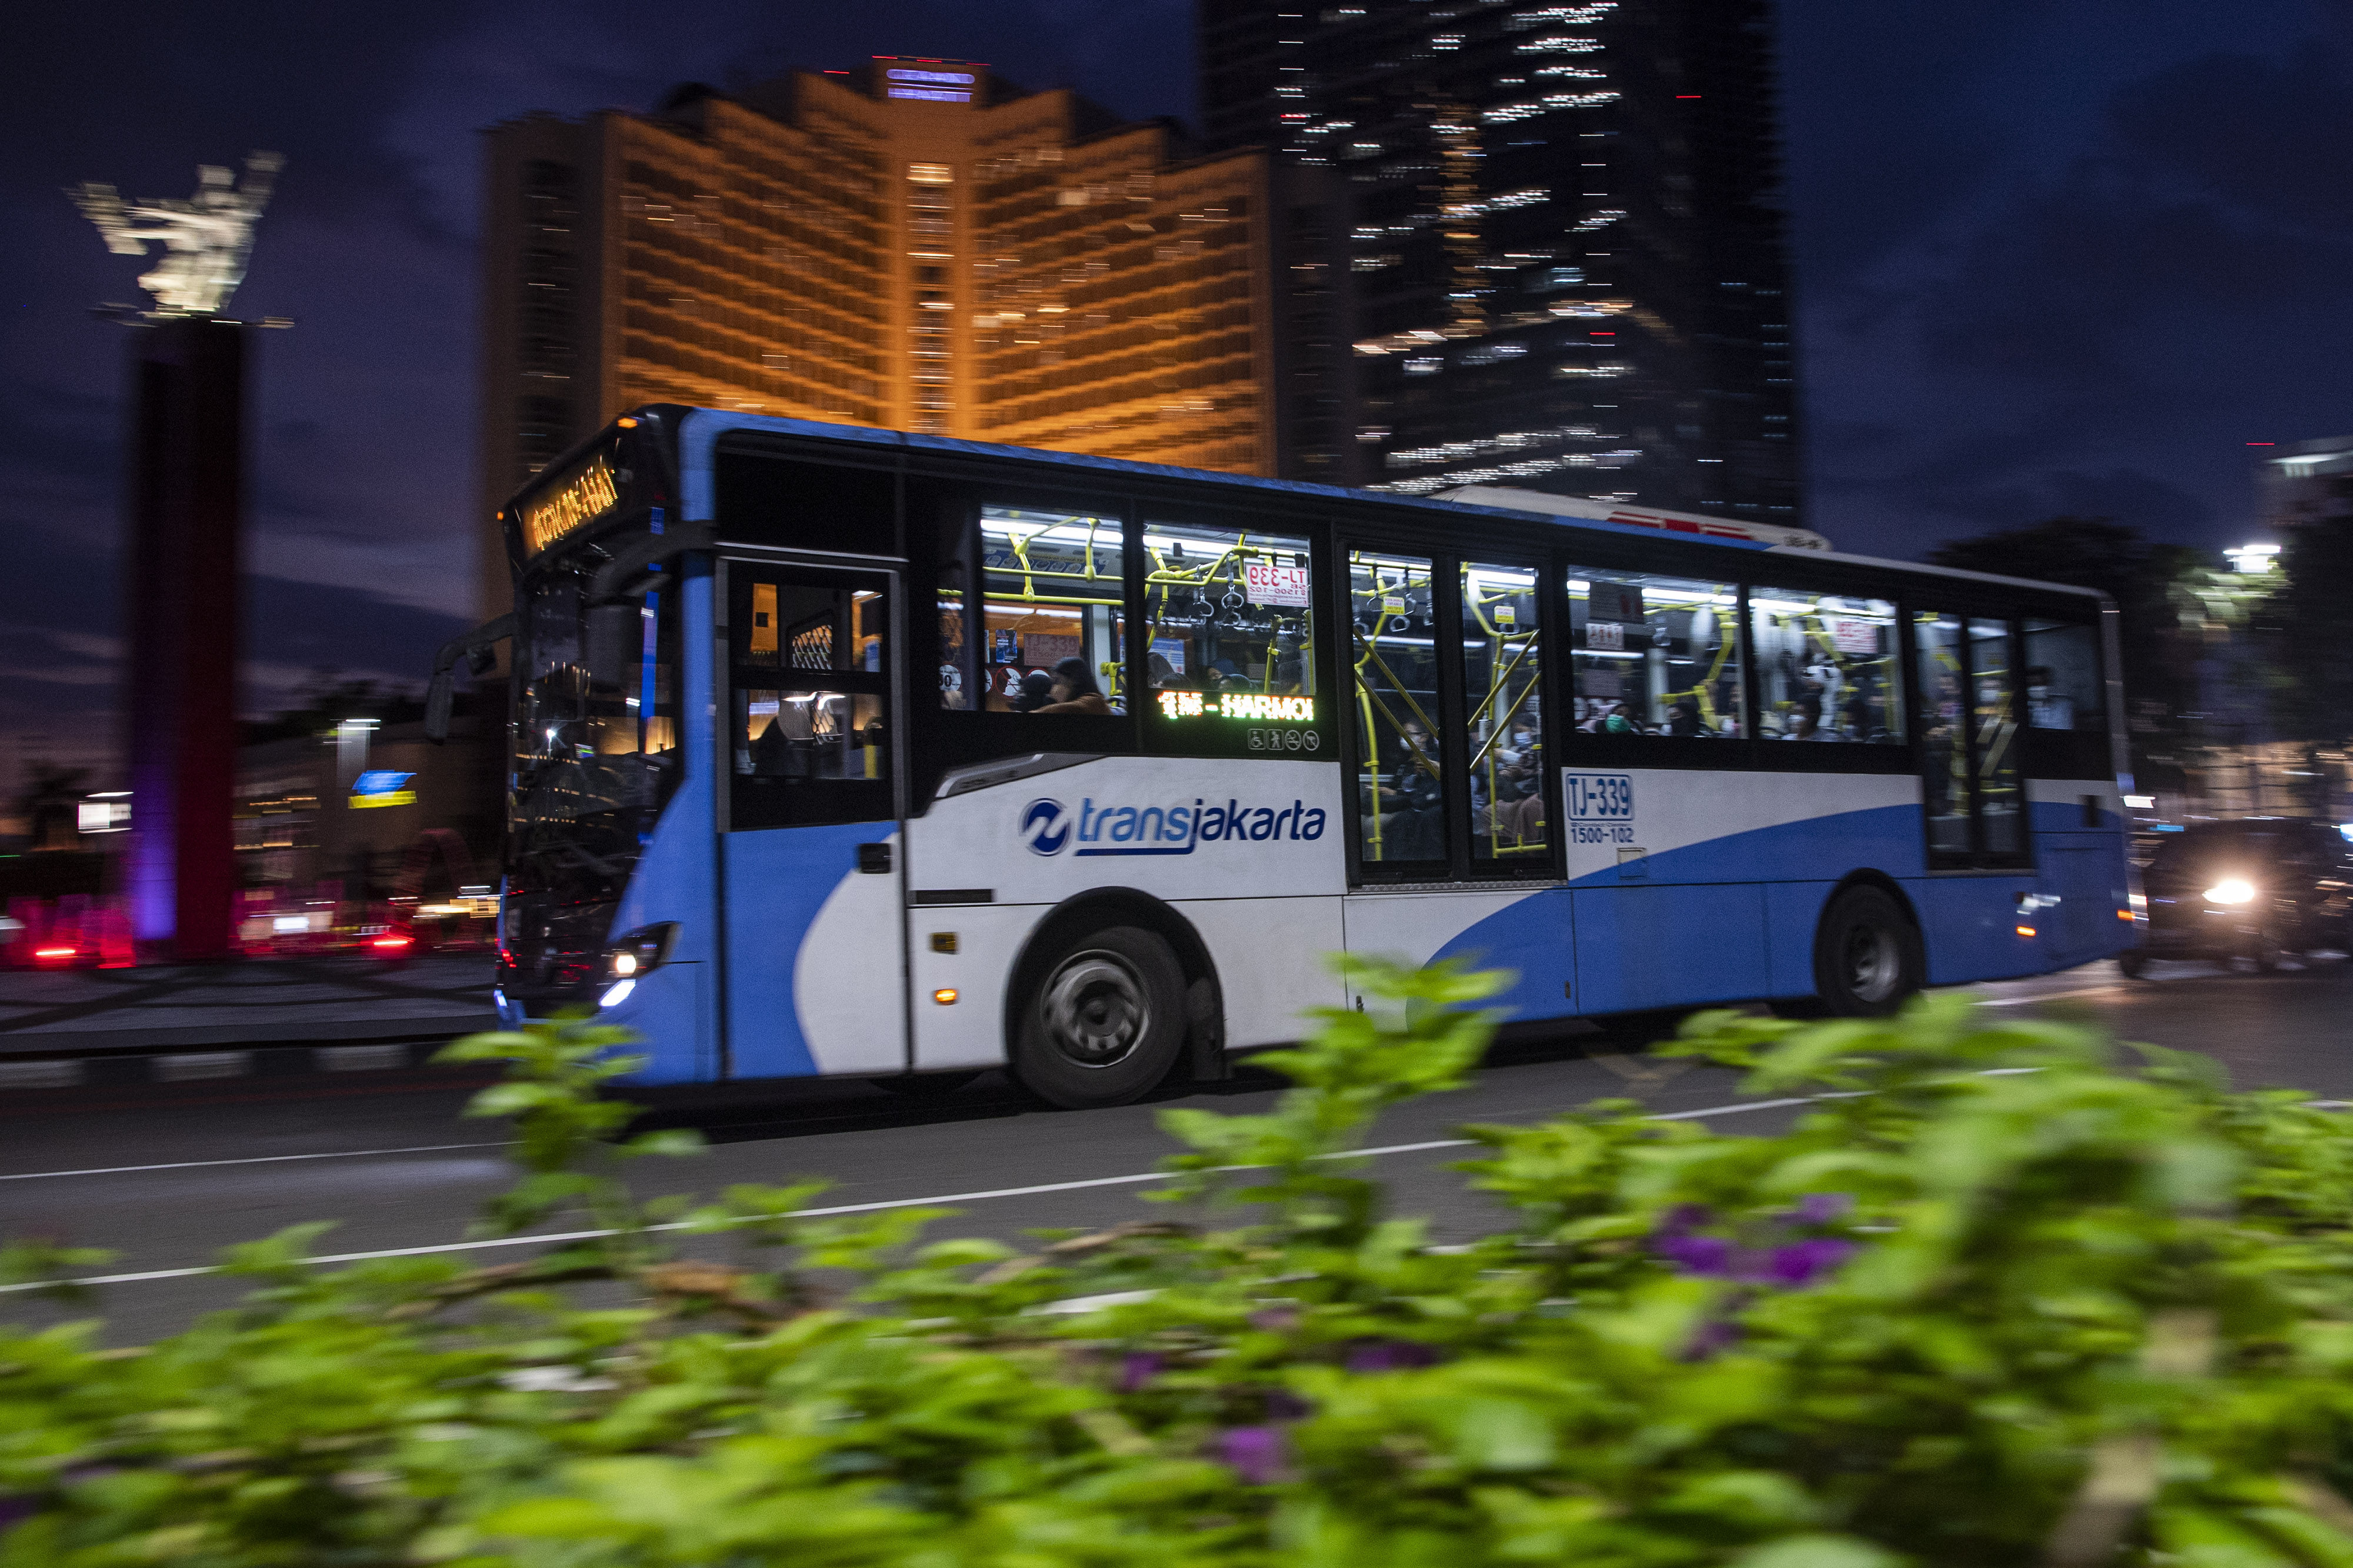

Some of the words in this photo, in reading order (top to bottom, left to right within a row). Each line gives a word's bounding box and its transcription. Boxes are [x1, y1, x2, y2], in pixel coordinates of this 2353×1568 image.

[1569, 778, 1629, 816] TJ-339
[1075, 797, 1327, 856] transjakarta
[1570, 827, 1634, 843] 1500-102
